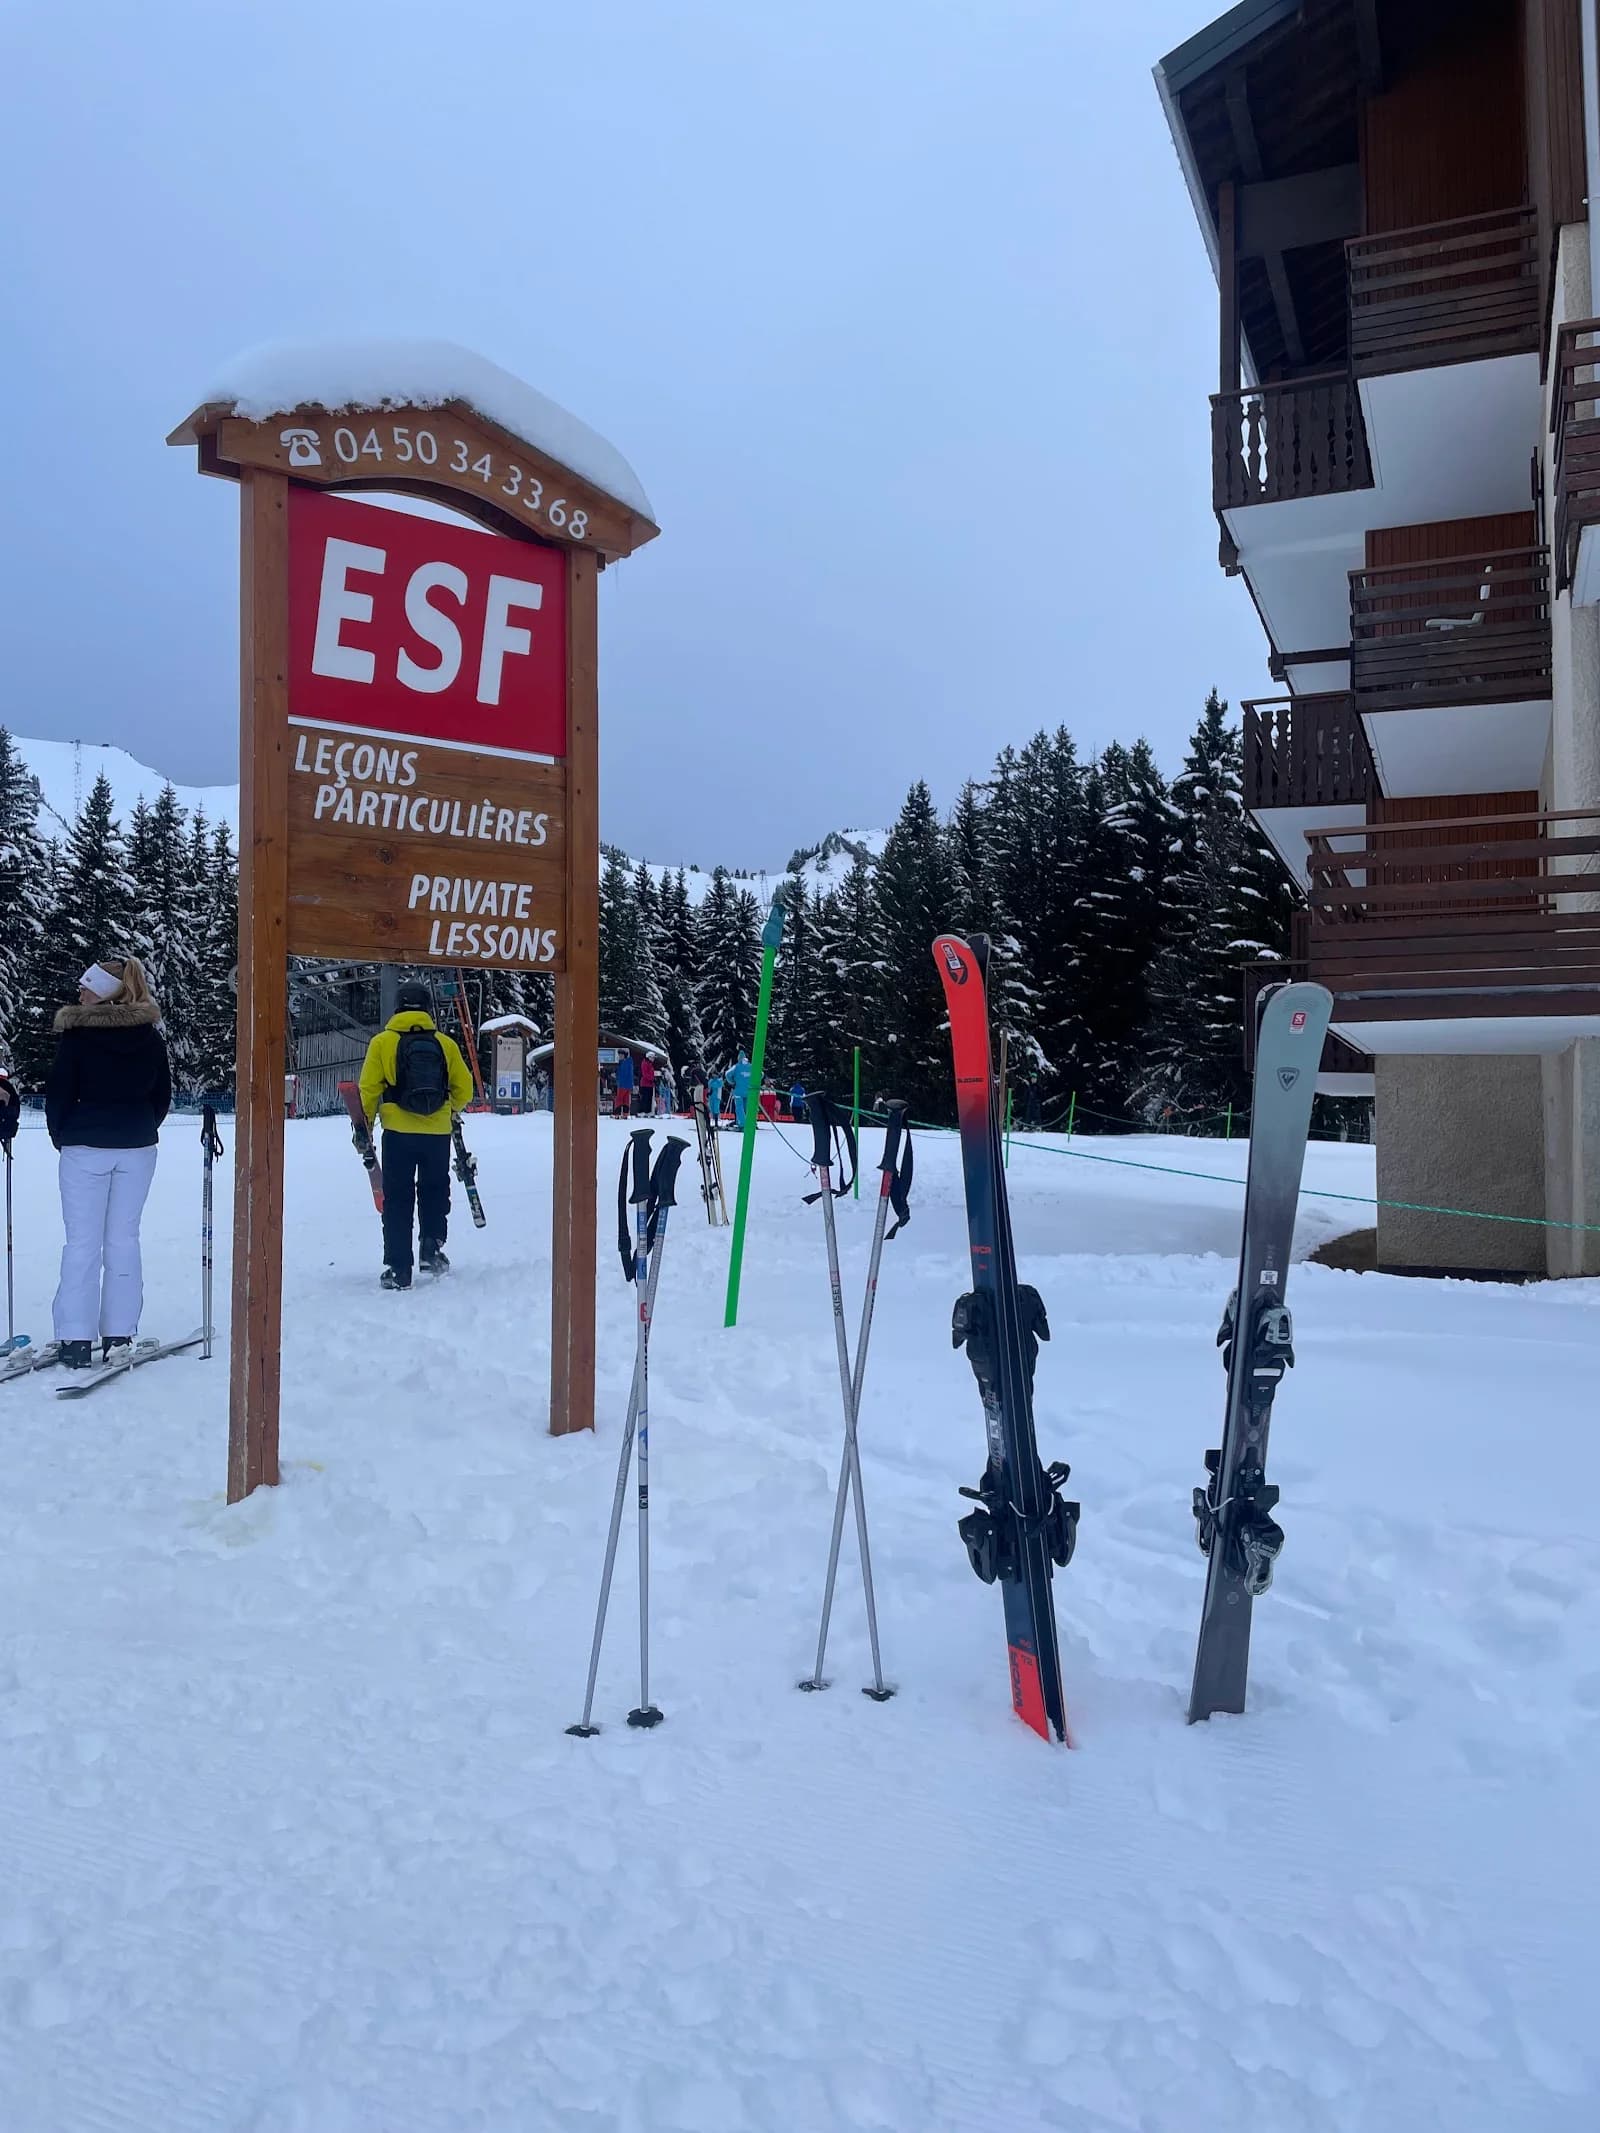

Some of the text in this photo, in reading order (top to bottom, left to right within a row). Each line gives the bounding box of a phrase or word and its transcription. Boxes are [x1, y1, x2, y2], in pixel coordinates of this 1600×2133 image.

[334, 427, 588, 540] 04 50 34 33 68
[311, 536, 543, 706] ESF
[294, 734, 418, 789] LEÇONS
[313, 784, 549, 846] PARTICULIÈRES
[407, 874, 533, 919] PRIVATE
[428, 919, 557, 962] LESSONS
[831, 1284, 842, 1317] SKISET
